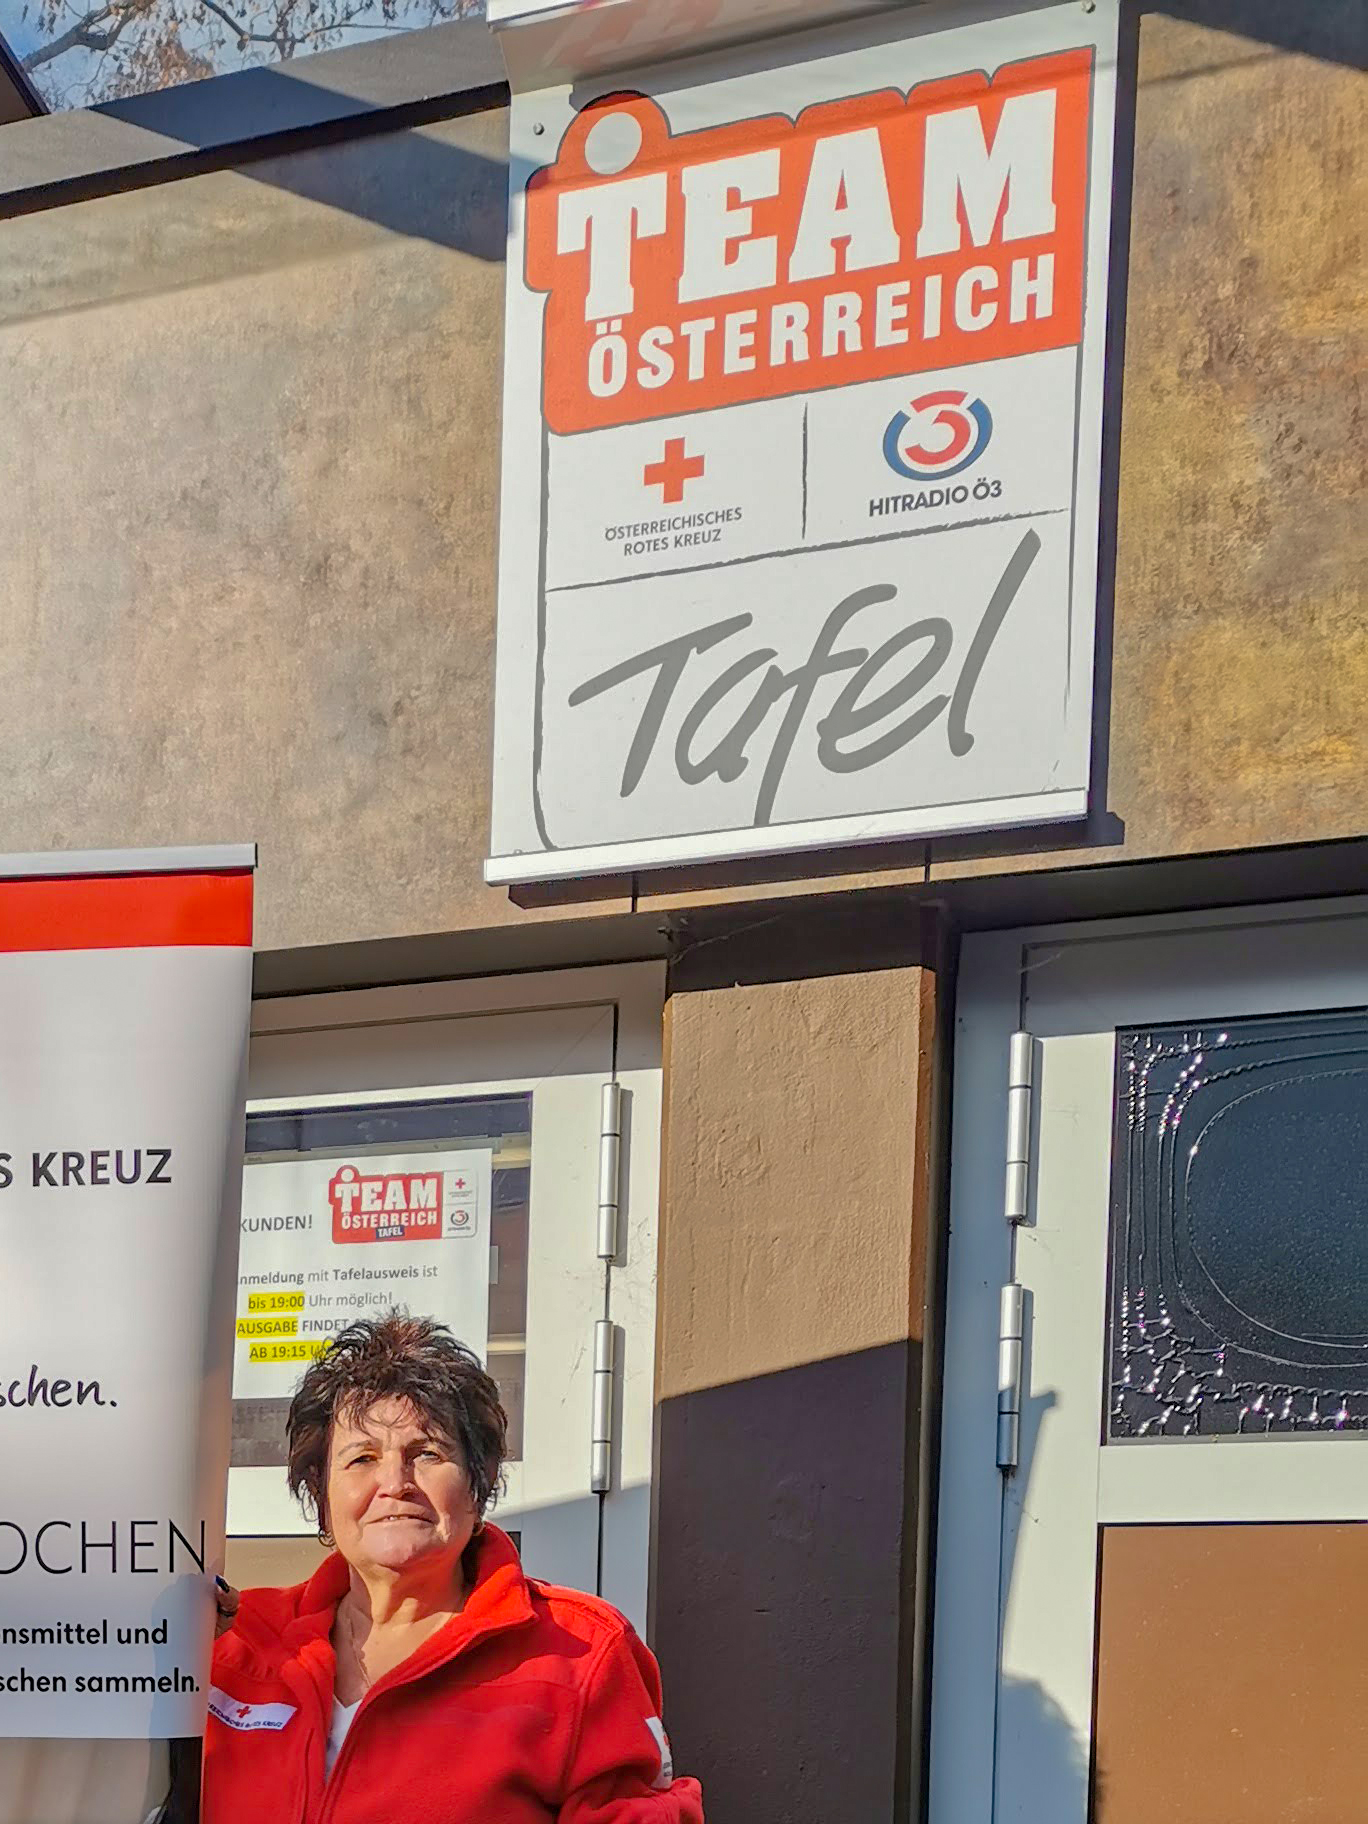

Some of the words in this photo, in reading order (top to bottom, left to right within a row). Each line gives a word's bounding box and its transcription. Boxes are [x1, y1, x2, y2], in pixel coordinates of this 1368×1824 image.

[556, 88, 1058, 323] TEAM
[588, 253, 1055, 398] ÖSTERREICH
[869, 482, 969, 518] HITRADIO
[972, 479, 1003, 508] Ö3
[605, 506, 743, 541] ÖSTERREICHISCHES
[623, 537, 670, 557] ROTES
[674, 528, 722, 553] KREUZ
[568, 531, 1041, 823] Tafel
[32, 1148, 172, 1188] KREUZ
[335, 1177, 438, 1213] TEAM
[341, 1211, 437, 1230] ÖSTERREICH
[377, 1226, 403, 1237] TAFEL
[238, 1272, 304, 1286] nmeldung
[308, 1269, 329, 1282] mit
[333, 1266, 419, 1280] Tafelausweis
[423, 1266, 438, 1277] ist
[249, 1297, 266, 1309] bis
[271, 1296, 305, 1308] 19:00
[309, 1294, 332, 1307] Uhr
[336, 1292, 392, 1308] möglich!
[237, 1321, 298, 1334] AUSGABE
[250, 1348, 267, 1358] AB
[272, 1346, 306, 1357] 19:15
[116, 1618, 168, 1645] und
[74, 1666, 200, 1694] sammeln.
